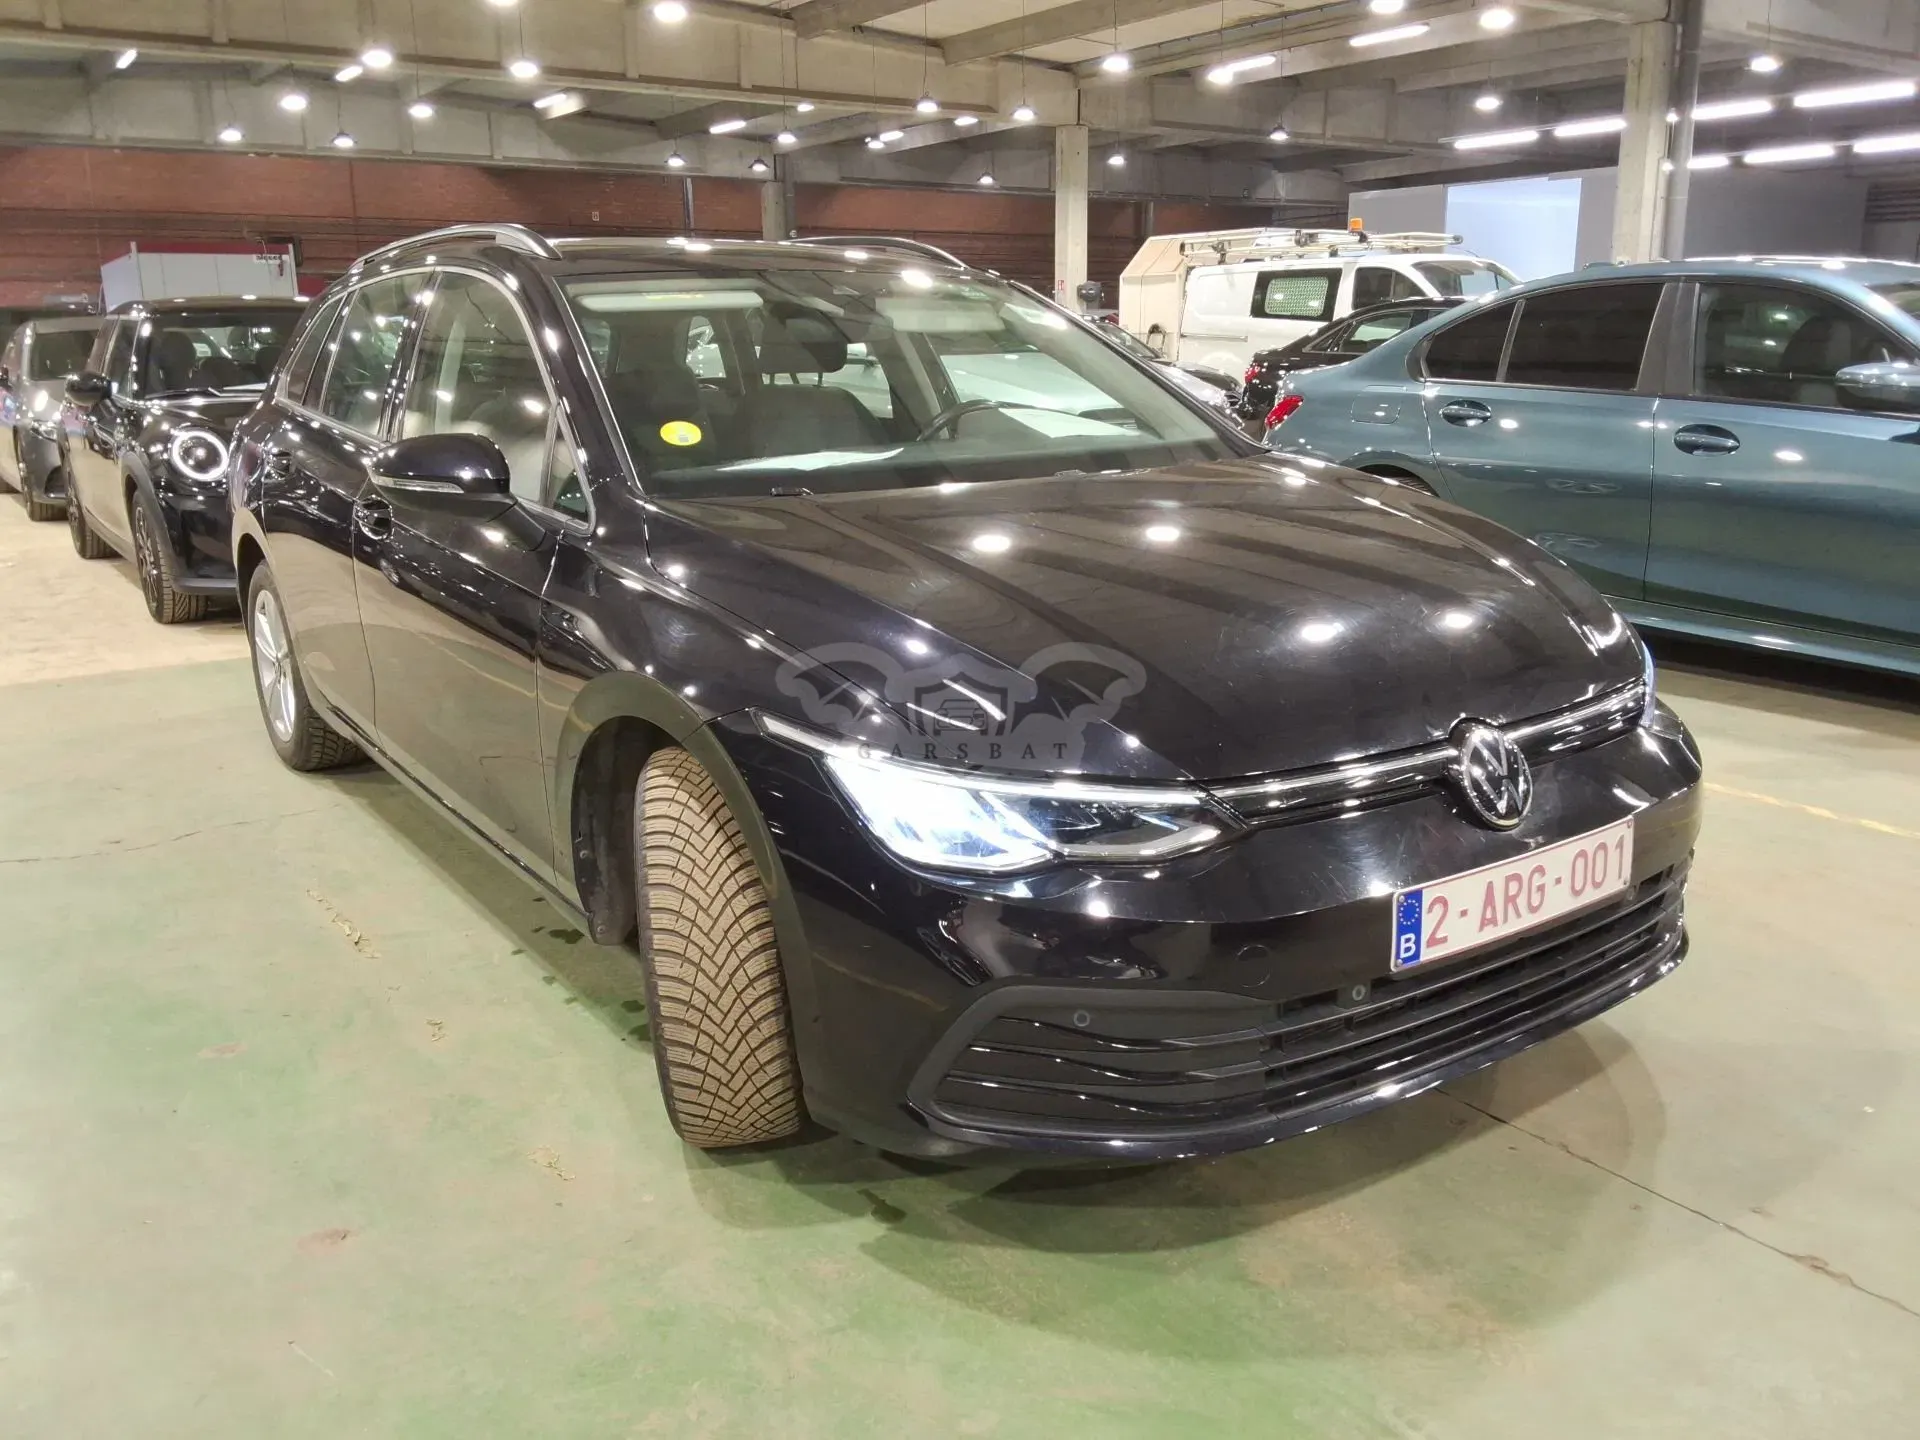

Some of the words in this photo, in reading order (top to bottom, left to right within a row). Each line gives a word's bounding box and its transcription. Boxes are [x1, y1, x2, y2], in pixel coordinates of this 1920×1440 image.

[1462, 727, 1532, 826] VW
[1400, 933, 1416, 958] B
[1426, 834, 1625, 948] 2-ARG-001
